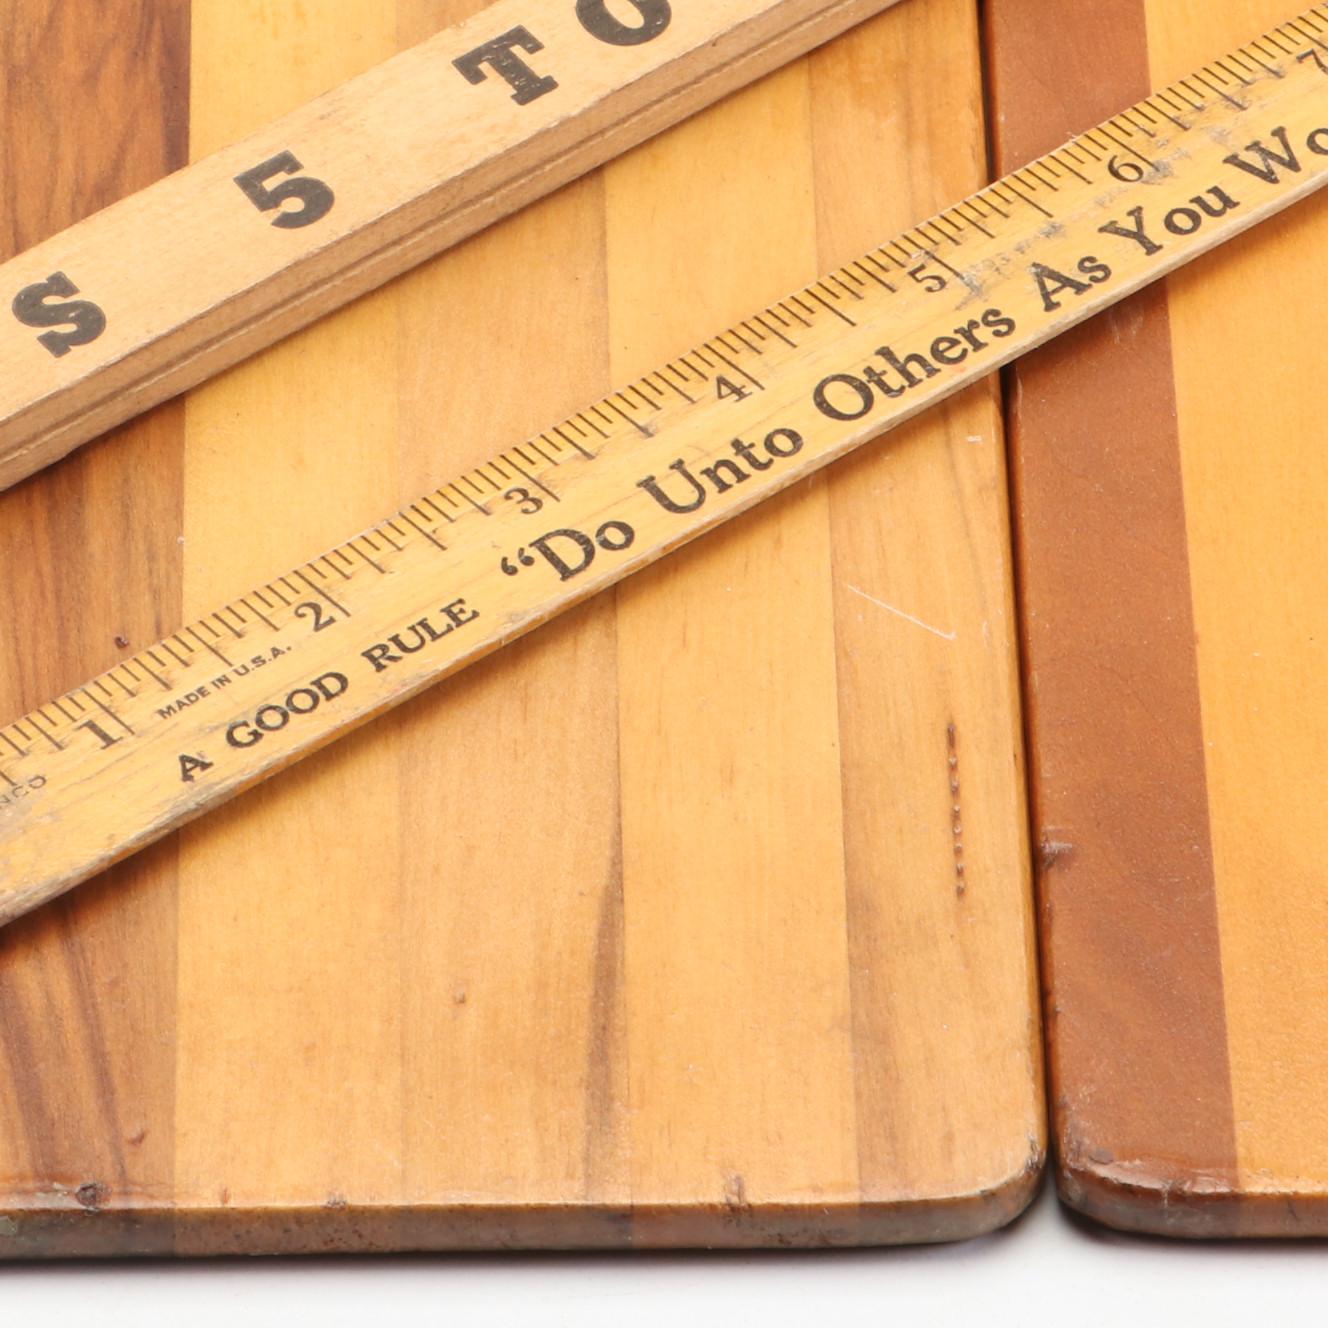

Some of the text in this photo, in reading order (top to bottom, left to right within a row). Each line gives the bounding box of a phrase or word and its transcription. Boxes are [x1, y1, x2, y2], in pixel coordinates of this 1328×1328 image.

[235, 149, 335, 229] 5
[73, 718, 123, 751] 1
[294, 600, 337, 633] 2
[503, 487, 545, 516] 3
[714, 374, 755, 405] 4
[908, 262, 947, 294] 5
[1107, 154, 1145, 183] 6
[1295, 49, 1328, 74] 7
[636, 423, 804, 516] Unto
[812, 305, 1017, 423] Others
[1032, 252, 1112, 313] As
[1098, 185, 1240, 256] You
[156, 646, 292, 719] MADE IN U.S.A.
[177, 598, 480, 784] A GOOD RULE
